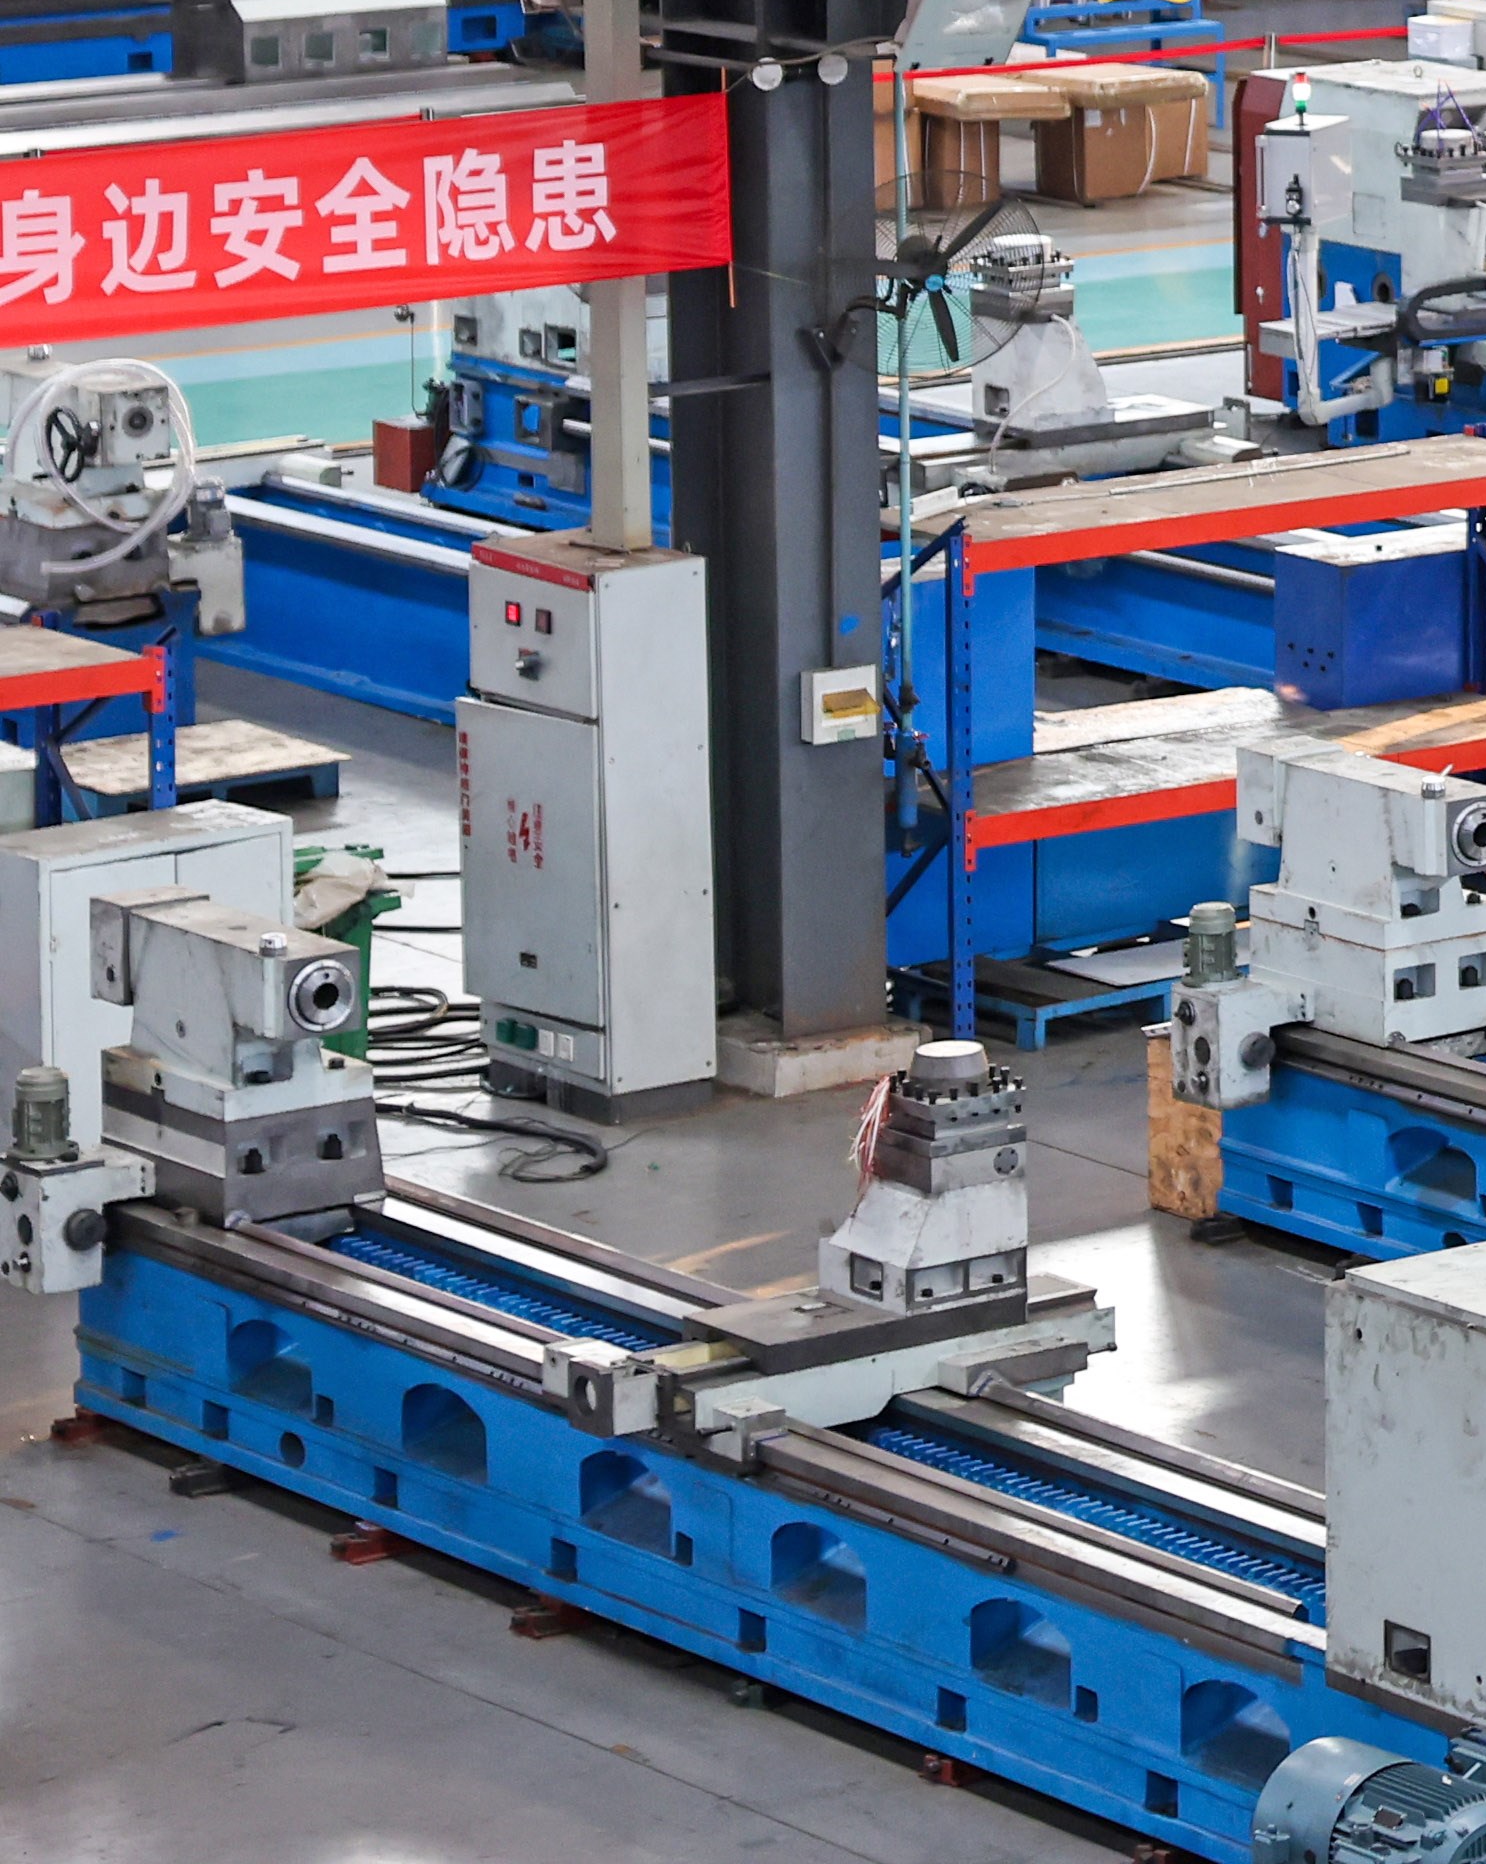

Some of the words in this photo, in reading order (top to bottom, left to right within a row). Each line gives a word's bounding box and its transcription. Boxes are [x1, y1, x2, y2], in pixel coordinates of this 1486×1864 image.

[0, 138, 618, 306] 身边安全隐患
